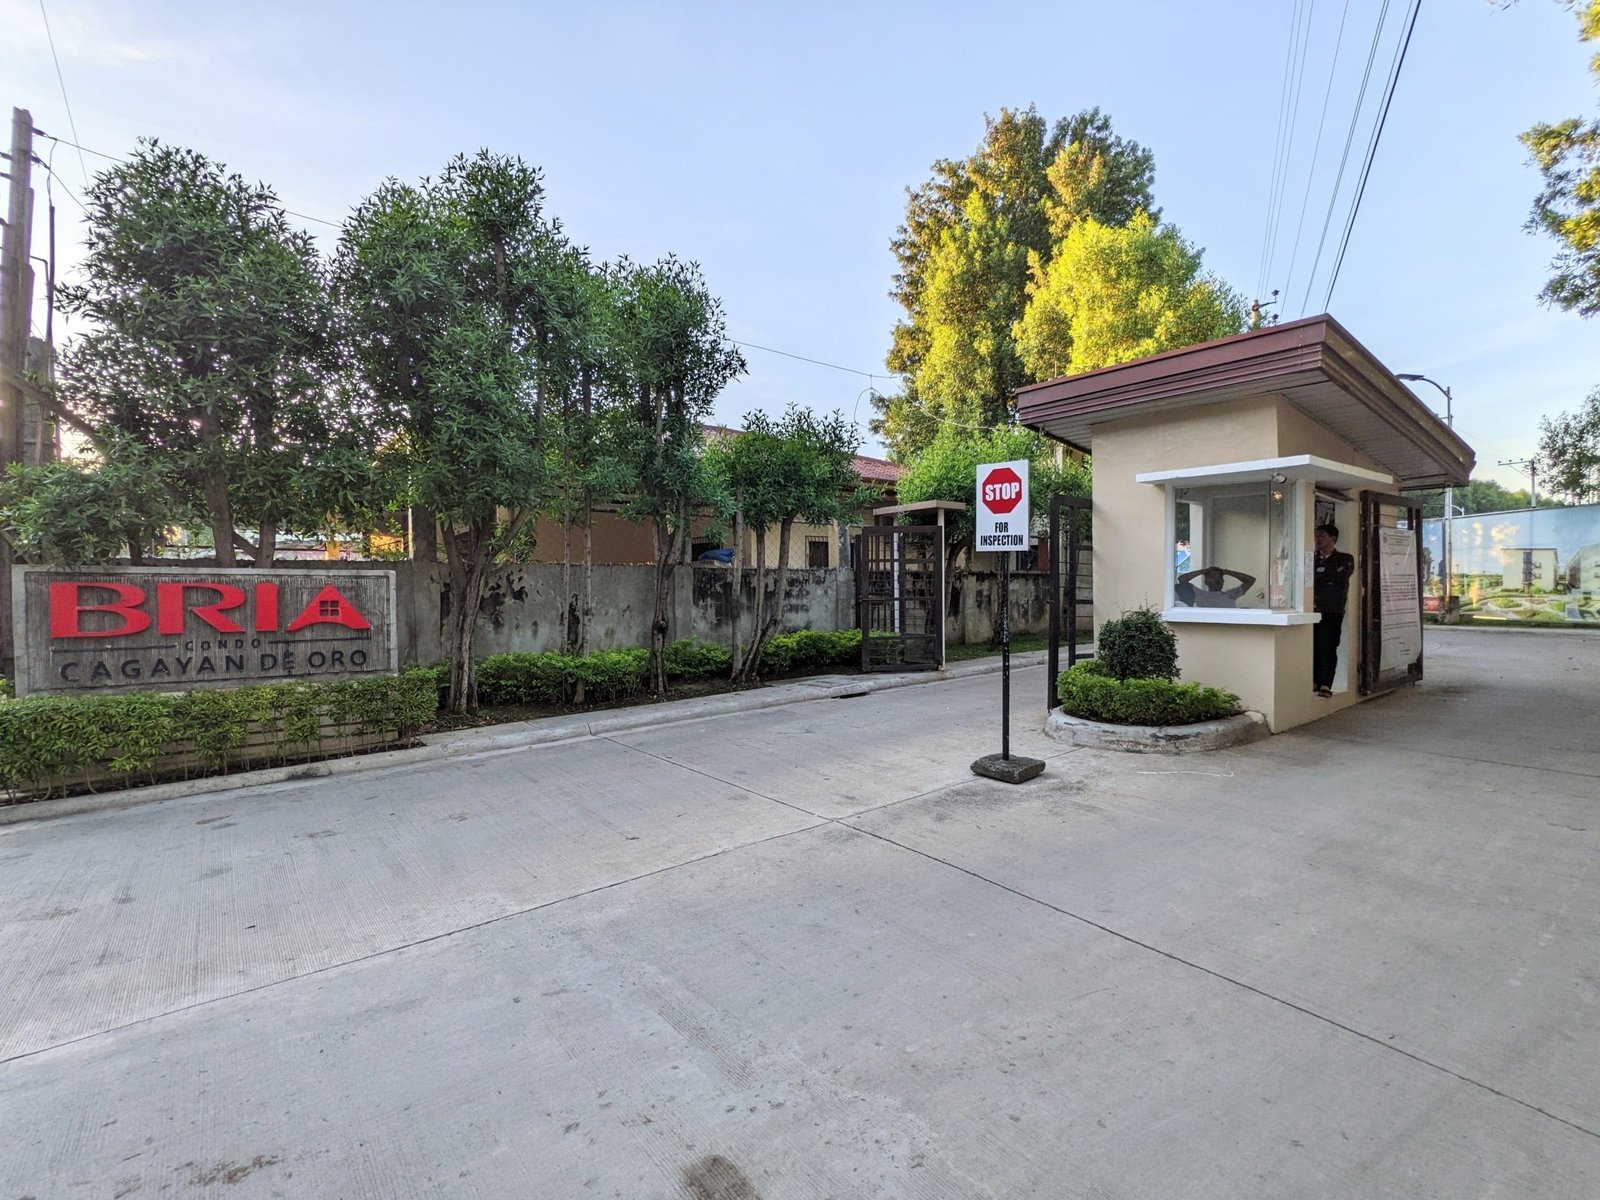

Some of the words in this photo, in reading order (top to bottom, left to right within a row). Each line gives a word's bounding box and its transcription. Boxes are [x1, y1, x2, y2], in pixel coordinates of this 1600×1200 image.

[985, 482, 1020, 501] STOP
[994, 522, 1009, 533] FOR
[980, 535, 1024, 546] INSPECTION
[49, 582, 372, 638] BRIA
[185, 638, 261, 651] CONDO
[60, 654, 244, 681] CAGAYAN
[260, 652, 294, 671] DE
[307, 650, 367, 668] ORO
